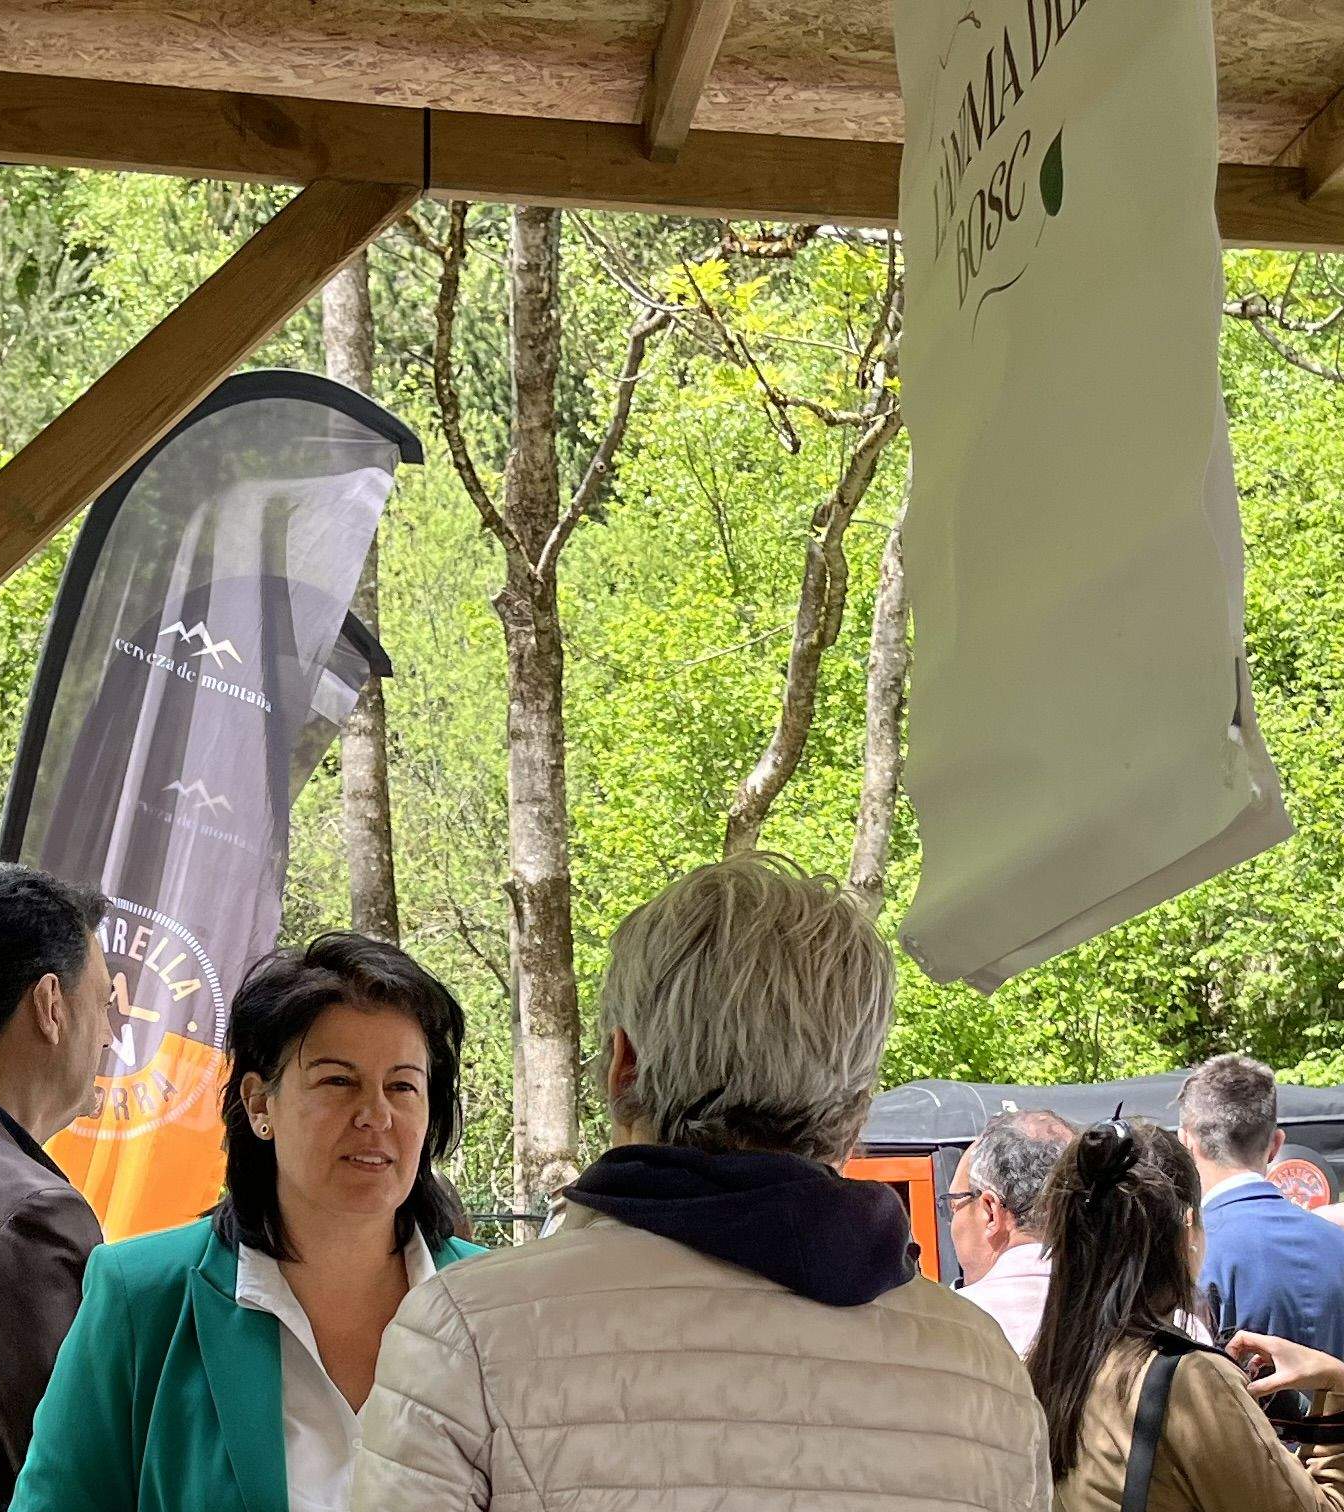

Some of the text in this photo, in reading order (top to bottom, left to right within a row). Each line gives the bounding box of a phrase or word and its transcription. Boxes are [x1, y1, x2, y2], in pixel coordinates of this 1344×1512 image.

[957, 129, 1031, 311] BOSC
[175, 661, 198, 684] de
[200, 674, 274, 715] montaña
[96, 915, 202, 1003] TRELLA
